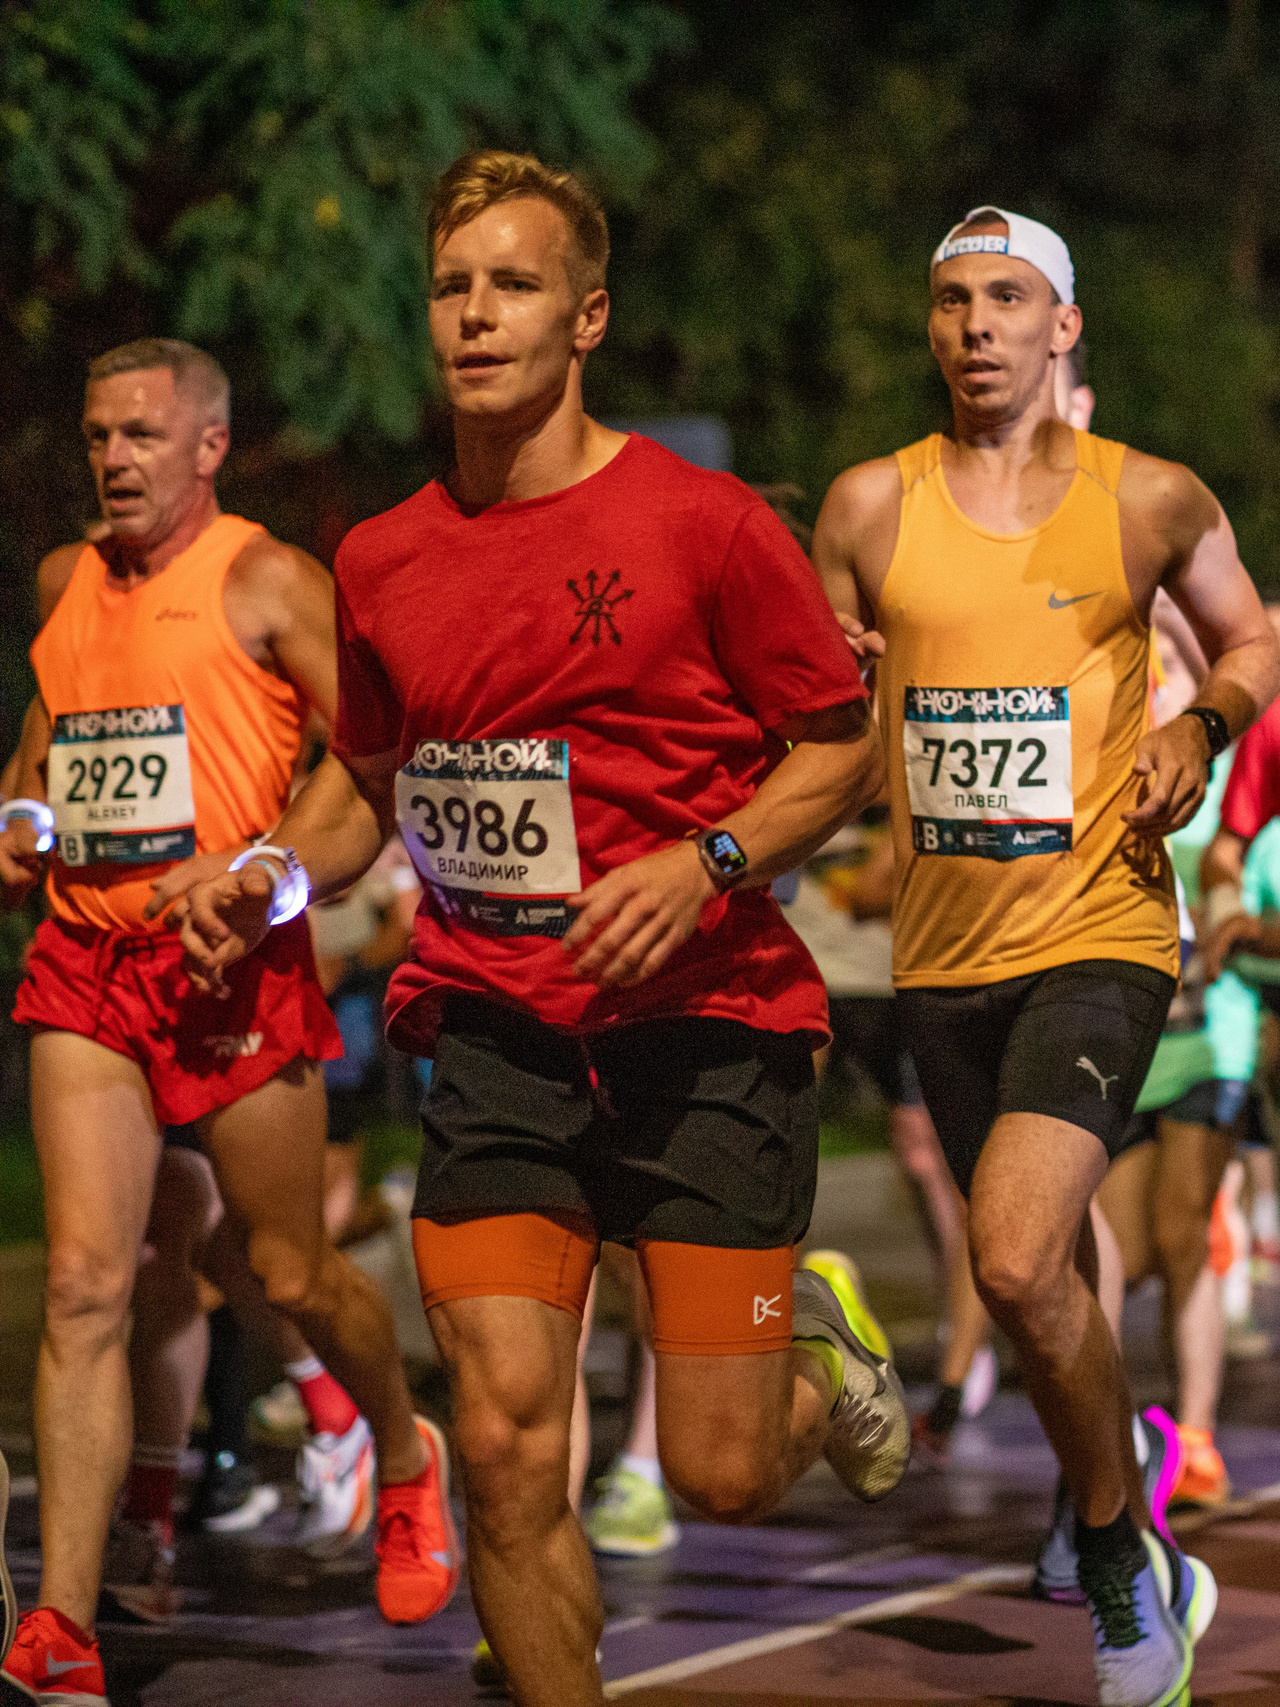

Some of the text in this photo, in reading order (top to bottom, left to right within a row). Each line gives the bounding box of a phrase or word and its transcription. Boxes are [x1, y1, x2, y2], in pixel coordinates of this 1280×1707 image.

[914, 687, 1057, 715] НОЧНОЙ
[66, 754, 168, 804] 2929
[922, 737, 1048, 788] 7372
[954, 794, 1008, 809] ПАВЕЛ
[410, 794, 549, 858] 3986
[436, 856, 529, 881] ВЛАДИМИР
